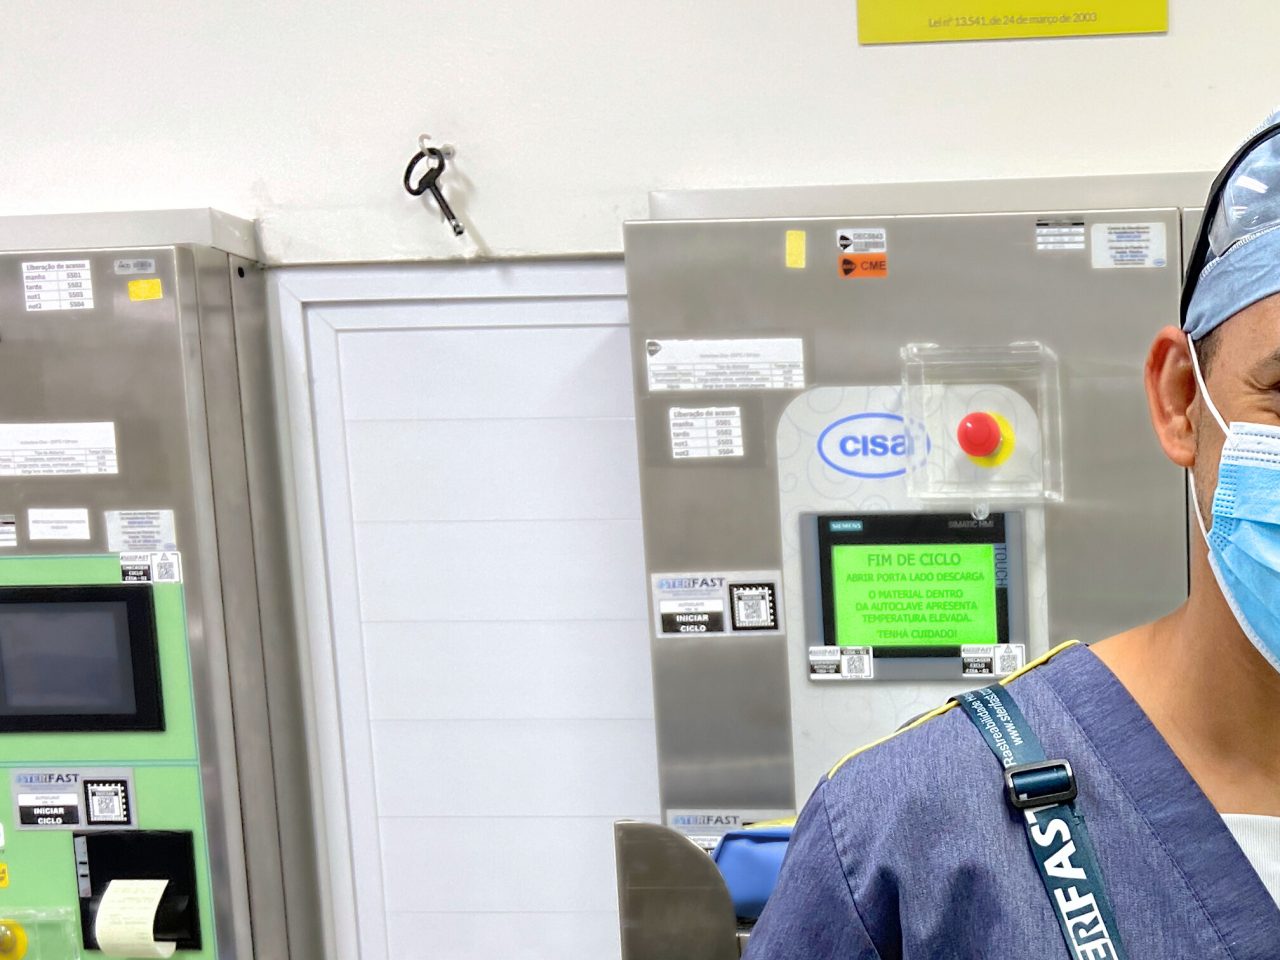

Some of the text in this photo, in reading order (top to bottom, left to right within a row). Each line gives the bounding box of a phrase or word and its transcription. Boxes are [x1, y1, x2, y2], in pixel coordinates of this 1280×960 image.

[1003, 15, 1015, 25] 24
[1072, 12, 1097, 23] 2003
[860, 261, 887, 271] CME
[867, 552, 962, 567] FIM DE CICLO
[995, 545, 1008, 588] TOUCH
[846, 572, 985, 582] ABRIR PORTA LADO DESCARGA
[868, 589, 963, 599] O MATERIAL DENTRO
[855, 601, 978, 611] DA AUTOCLAVE APRESENTA
[676, 614, 709, 622] INICIAR
[862, 613, 927, 623] TEMPERATURA
[878, 629, 909, 639] TENHA
[971, 700, 1017, 768] Rastreabilidade
[33, 806, 65, 815] INICIAR
[37, 816, 62, 825] CICLO
